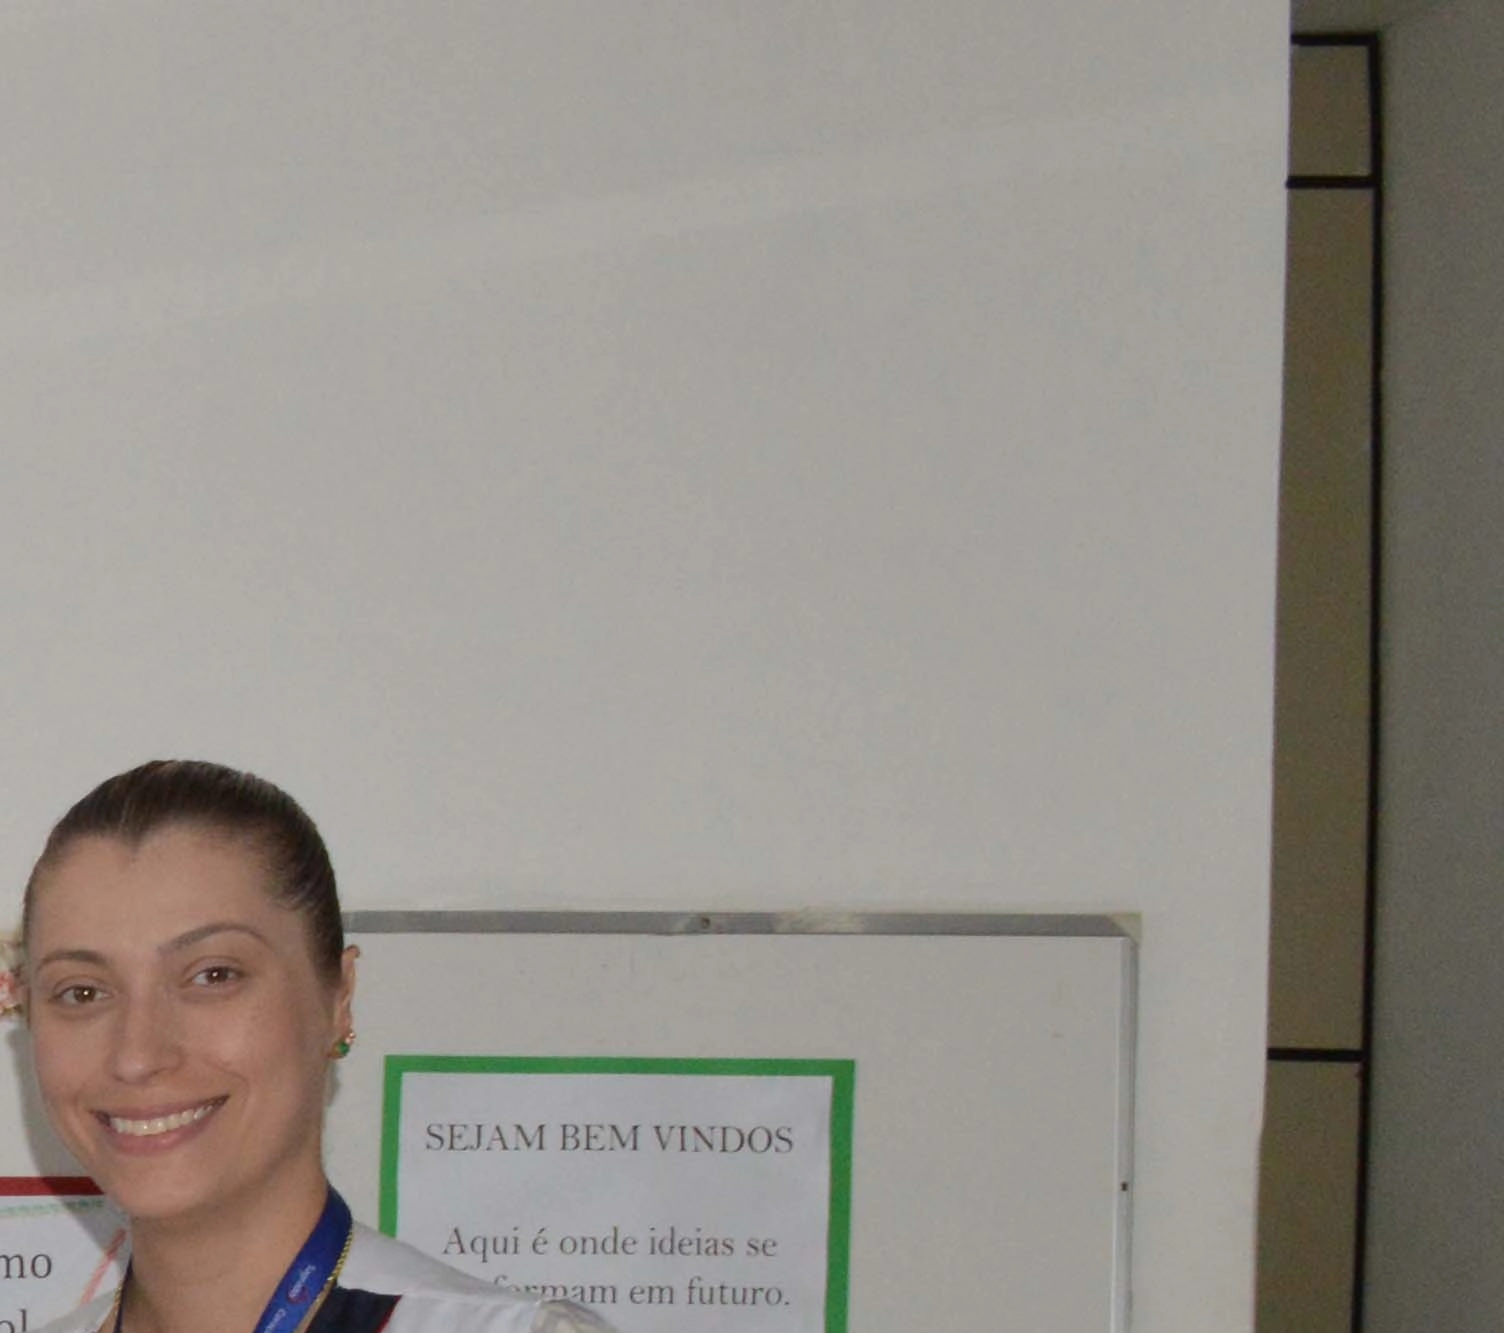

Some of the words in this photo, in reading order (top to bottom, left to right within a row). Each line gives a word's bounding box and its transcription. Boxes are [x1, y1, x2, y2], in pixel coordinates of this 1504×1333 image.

[425, 1123, 547, 1152] SEJAM
[560, 1124, 640, 1152] BEM
[654, 1125, 794, 1154] VINDOS
[443, 1227, 520, 1263] Aqui
[532, 1228, 548, 1256] é
[559, 1228, 638, 1256] onde
[648, 1227, 734, 1257] ideias
[745, 1236, 778, 1258] se
[629, 1284, 674, 1306] em
[686, 1274, 790, 1308] futuro.
